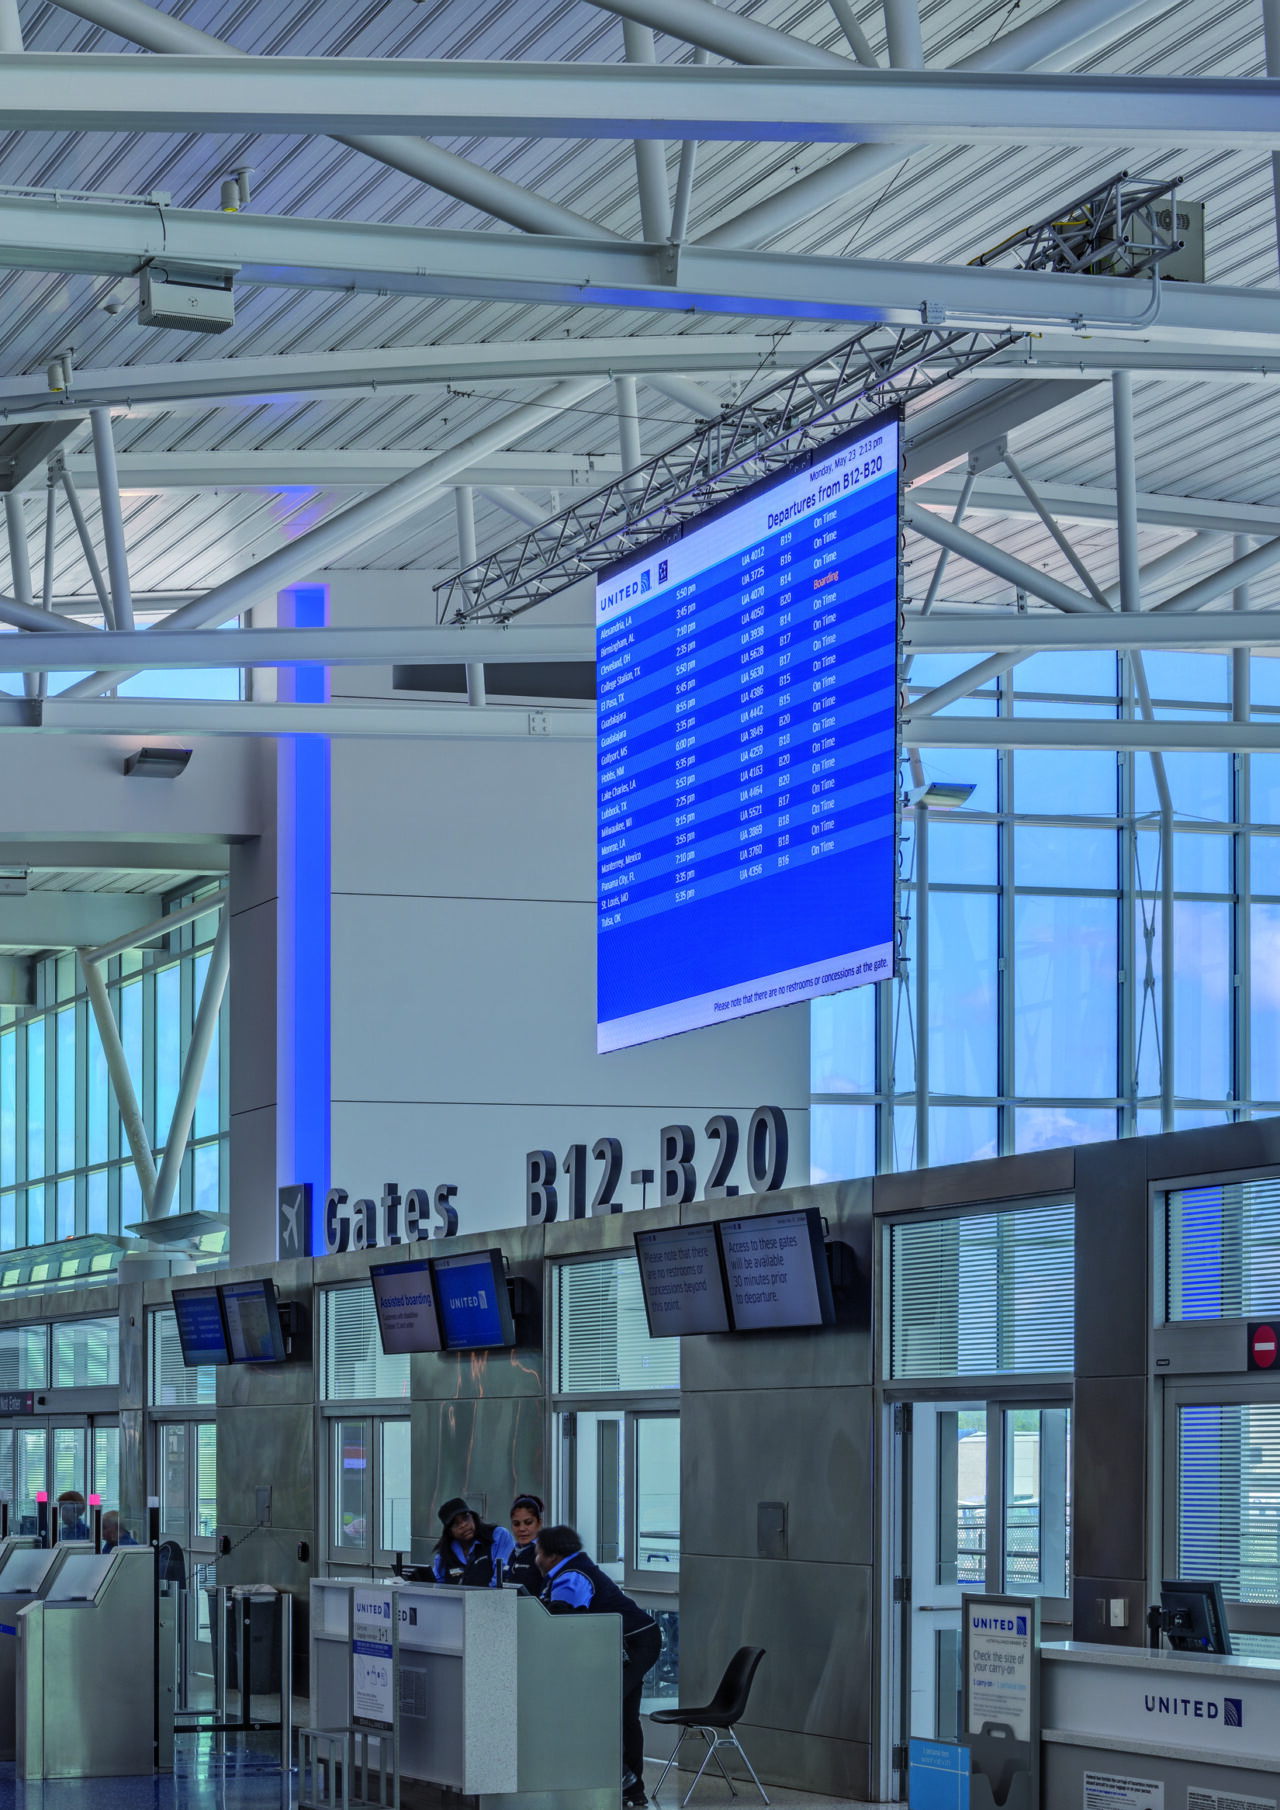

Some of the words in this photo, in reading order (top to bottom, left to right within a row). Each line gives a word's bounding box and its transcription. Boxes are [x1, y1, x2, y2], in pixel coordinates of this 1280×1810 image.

[809, 464, 832, 481] Monday,
[834, 456, 846, 467] May
[848, 449, 855, 461] 23
[858, 440, 872, 455] 2:13
[873, 436, 882, 448] pm
[767, 494, 815, 528] Departures
[818, 480, 840, 501] from
[843, 456, 882, 488] B12-B20
[600, 621, 624, 638] Alexandria,
[625, 616, 632, 626] LA
[676, 586, 687, 599] 5:50
[687, 583, 696, 595] pm
[741, 554, 750, 565] UA
[780, 532, 791, 545] B19
[813, 517, 822, 528] On
[823, 510, 836, 523] Time
[600, 638, 627, 657] Birmingham,
[628, 633, 634, 643] AL
[676, 605, 687, 618] 3:45
[687, 602, 695, 614] pm
[741, 573, 749, 585] UA
[780, 552, 791, 565] B16
[813, 538, 822, 548] On
[823, 531, 836, 543] Time
[600, 581, 638, 610] UNITED
[600, 657, 622, 675] Cleveland,
[623, 653, 630, 663] OH
[676, 624, 687, 636] 7:10
[687, 621, 695, 633] pm
[741, 593, 749, 605] UA
[780, 572, 791, 585] B14
[813, 558, 822, 569] On
[823, 551, 836, 564] Time
[600, 679, 616, 693] College
[616, 672, 633, 685] Station,
[634, 666, 640, 676] TX
[676, 643, 687, 656] 2:35
[687, 641, 695, 652] pm
[741, 613, 749, 624] UA
[780, 592, 791, 605] B20
[813, 571, 838, 589] Boarding
[618, 692, 624, 702] TX
[676, 662, 687, 675] 5:50
[687, 659, 695, 671] pm
[741, 632, 749, 644] UA
[779, 612, 790, 625] B14
[813, 599, 821, 609] On
[822, 592, 836, 605] Time
[676, 681, 686, 694] 5:45
[687, 679, 695, 690] pm
[741, 652, 749, 663] UA
[779, 632, 790, 646] B17
[812, 619, 821, 630] On
[822, 613, 836, 625] Time
[675, 700, 686, 712] 8:55
[687, 698, 695, 709] pm
[740, 672, 749, 683] UA
[779, 652, 790, 666] B17
[812, 640, 821, 650] On
[822, 634, 836, 646] Time
[676, 719, 686, 732] 3:35
[687, 717, 695, 728] pm
[740, 691, 749, 703] UA
[779, 672, 790, 686] B15
[812, 660, 821, 671] On
[822, 654, 836, 666] Time
[675, 738, 686, 750] 6:00
[687, 736, 695, 747] pm
[740, 711, 748, 722] UA
[779, 693, 790, 706] B15
[812, 681, 821, 691] On
[822, 675, 835, 687] Time
[713, 1001, 729, 1011] Please
[730, 997, 741, 1007] note
[742, 993, 752, 1004] that
[753, 990, 767, 1001] there
[768, 988, 777, 997] are
[778, 986, 785, 994] no
[786, 978, 813, 992] restrooms
[814, 976, 820, 985] or
[821, 967, 854, 983] concessions
[855, 964, 861, 974] at
[862, 962, 872, 972] the
[873, 958, 887, 971] gate.
[323, 1182, 459, 1254] Gates
[526, 1105, 789, 1225] B12-B20
[644, 1249, 663, 1264] Please
[664, 1249, 677, 1262] note
[678, 1247, 691, 1260] that
[691, 1246, 709, 1259] there
[728, 1241, 750, 1254] Access
[750, 1239, 758, 1251] to
[758, 1237, 778, 1250] these
[778, 1235, 798, 1250] gates
[647, 1269, 657, 1280] are
[657, 1268, 666, 1279] no
[666, 1266, 696, 1278] restrooms
[697, 1265, 704, 1275] or
[730, 1258, 743, 1270] will
[744, 1257, 753, 1269] be
[754, 1254, 785, 1268] available
[649, 1282, 684, 1296] concessions
[684, 1279, 707, 1295] beyond
[734, 1275, 743, 1288] 30
[743, 1273, 770, 1287] minutes
[771, 1271, 788, 1287] prior
[380, 1294, 405, 1309] Assisted
[405, 1292, 432, 1308] boarding
[450, 1296, 478, 1309] UNITED
[651, 1300, 664, 1312] this
[736, 1293, 744, 1305] to
[744, 1290, 779, 1305] departure.
[0, 1396, 8, 1410] Not
[9, 1395, 21, 1410] Enter
[356, 1603, 382, 1615] UNITED
[973, 1617, 1014, 1631] UNITED
[973, 1649, 991, 1661] Check
[992, 1651, 1003, 1663] the
[1004, 1653, 1017, 1664] size
[1017, 1654, 1025, 1665] of
[973, 1662, 988, 1673] your
[989, 1664, 1015, 1676] carry-on
[1144, 1694, 1219, 1720] UNITED
